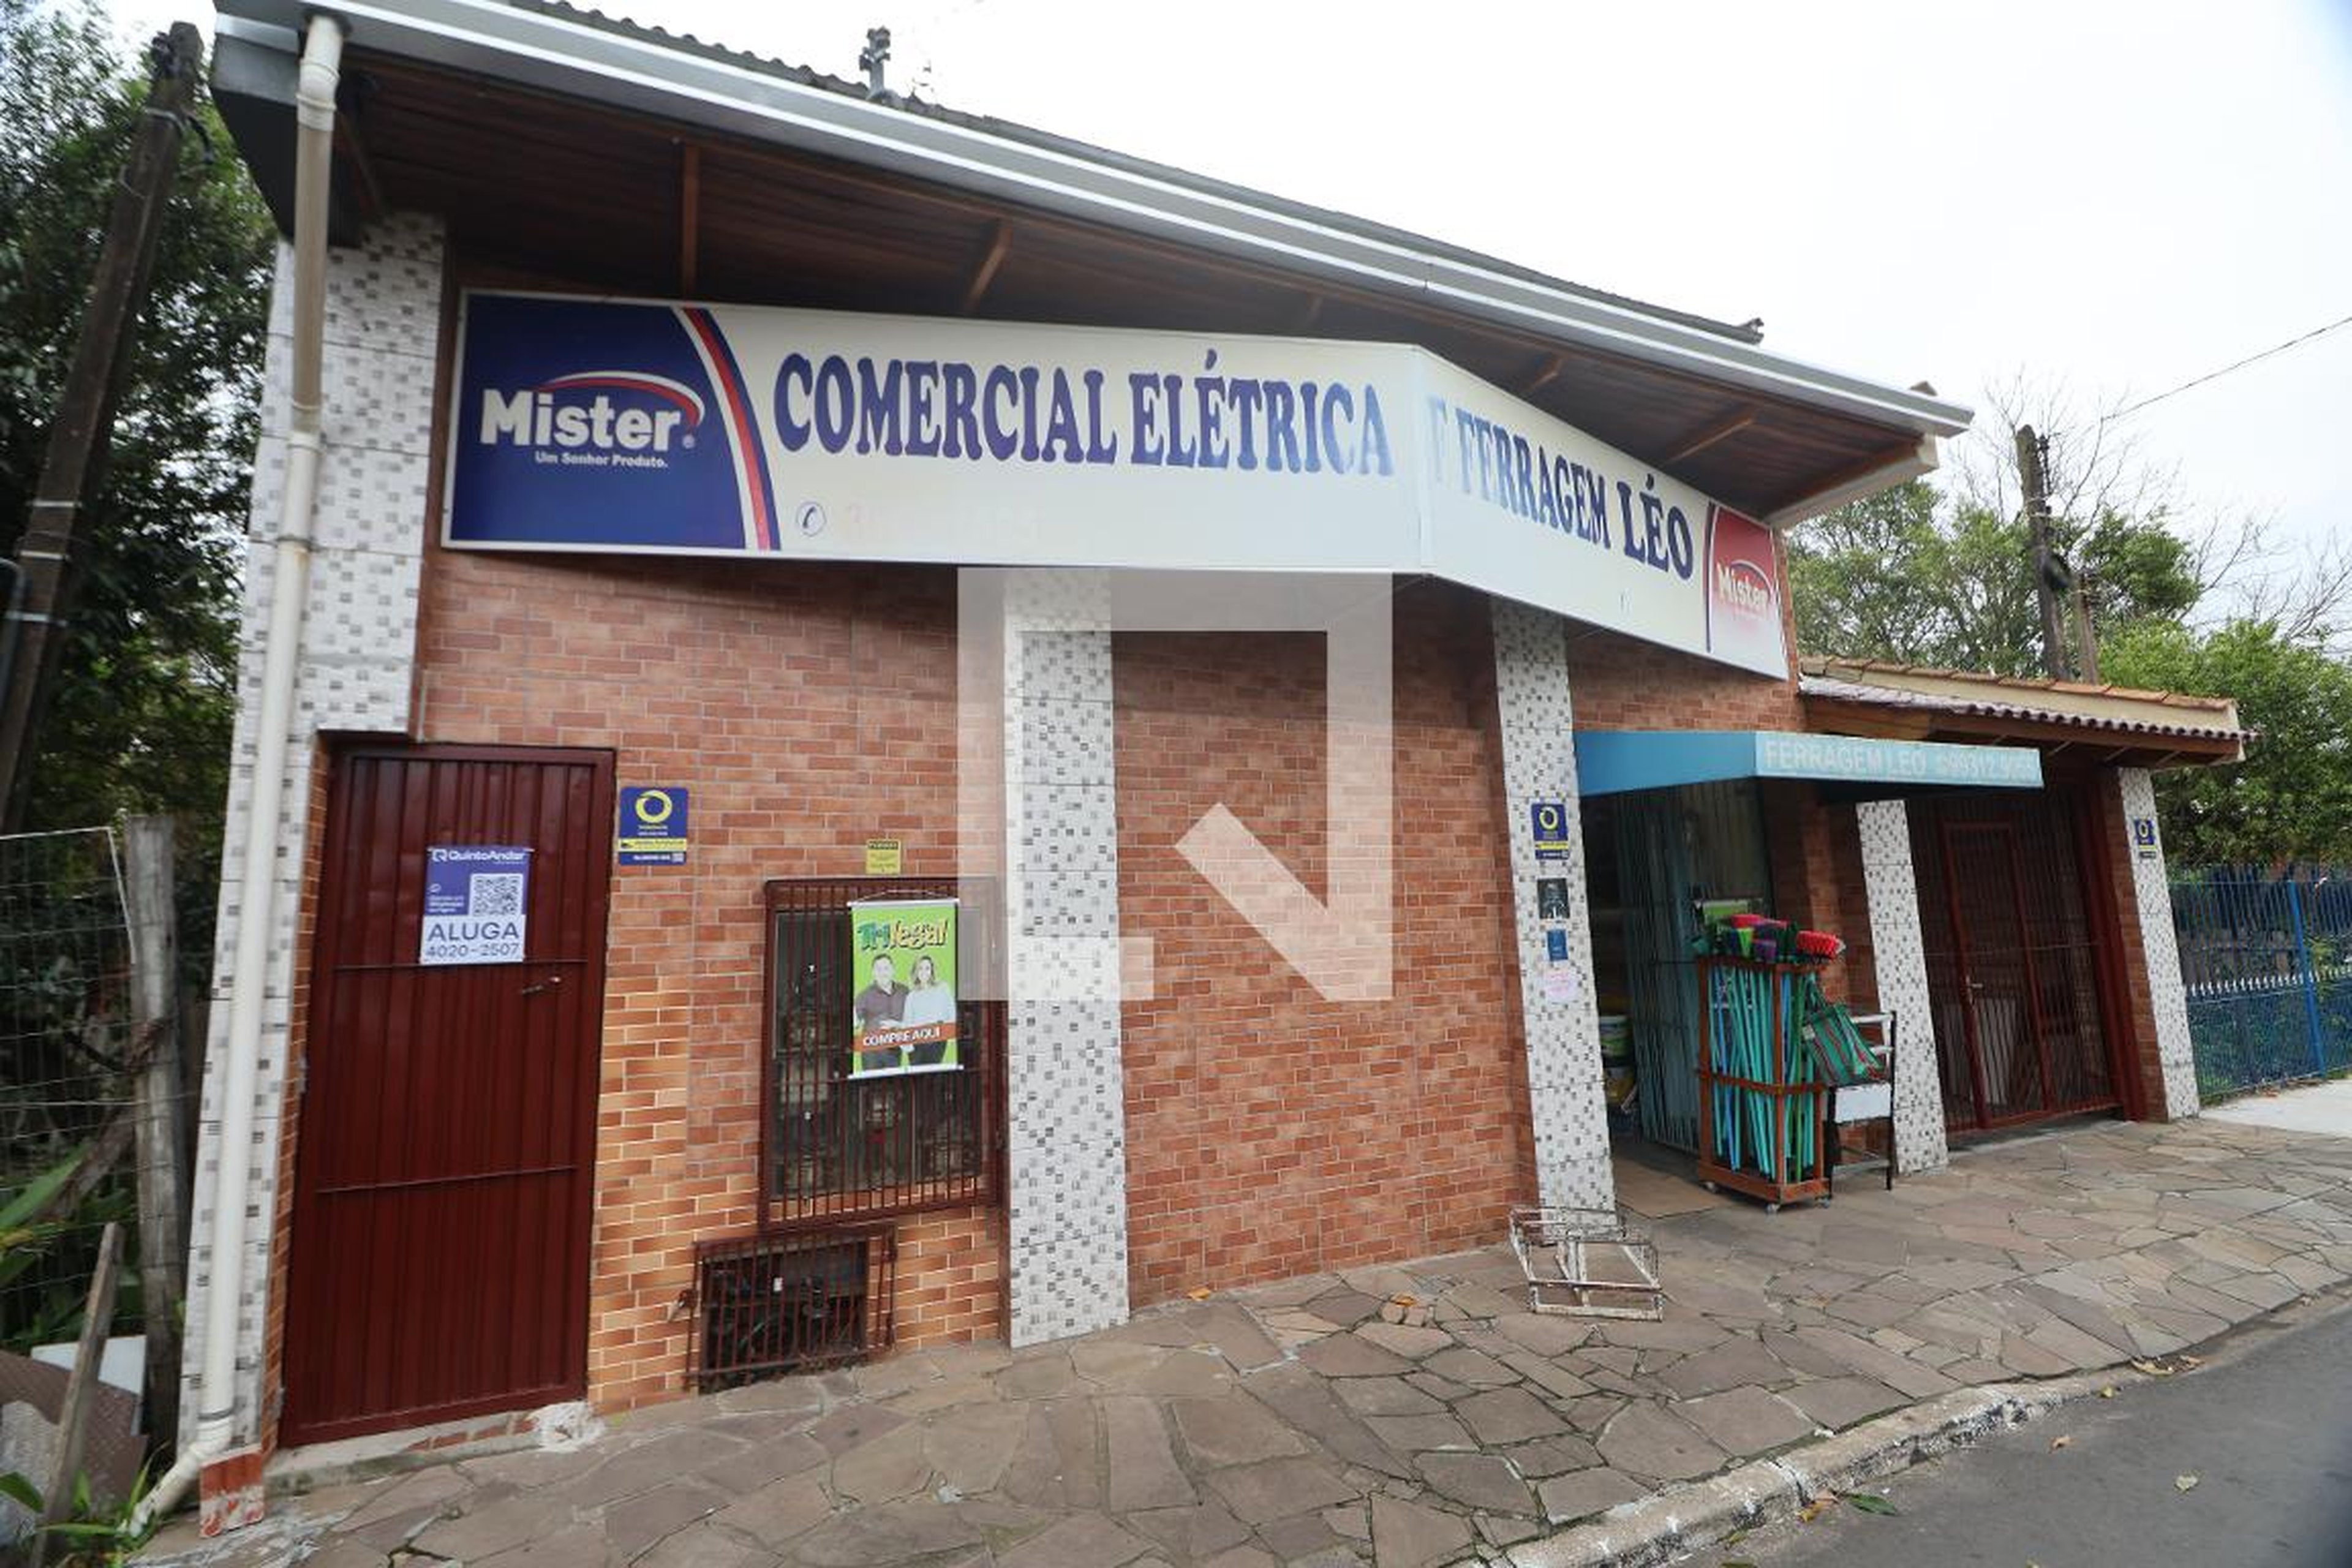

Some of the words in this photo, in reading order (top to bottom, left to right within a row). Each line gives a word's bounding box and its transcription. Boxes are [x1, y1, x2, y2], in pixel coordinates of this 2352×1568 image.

[480, 388, 680, 452] Mister
[774, 353, 1117, 464] COMERCIAL
[1128, 348, 1393, 475] ELÉTRICA
[1455, 407, 1611, 551] FERRAGEM
[1617, 472, 1694, 580] LÉO
[1717, 560, 1769, 612] Mister
[428, 921, 519, 941] ALUGA
[863, 1030, 911, 1046] COMPRE
[912, 1026, 940, 1041] AQUI
